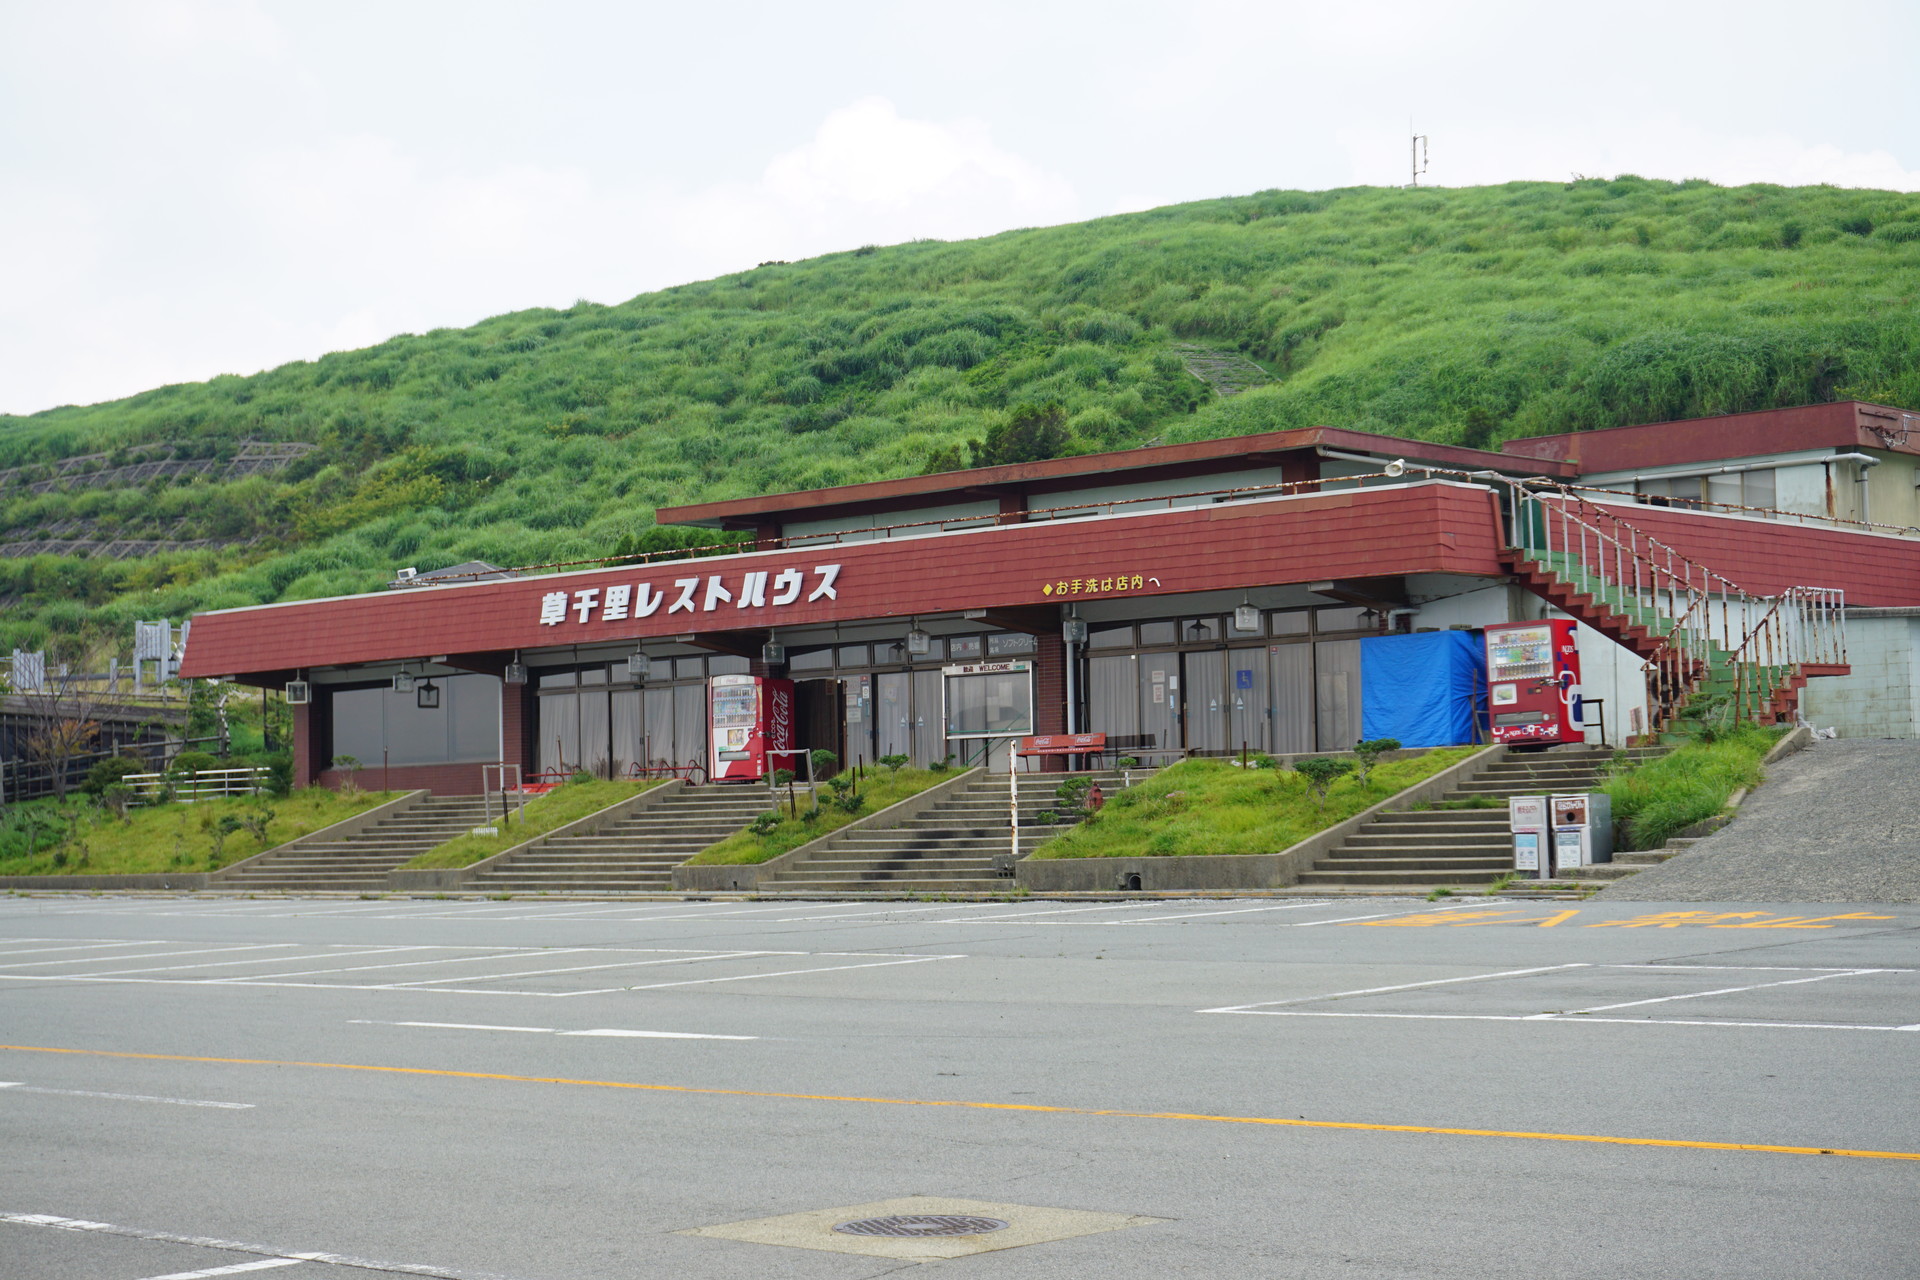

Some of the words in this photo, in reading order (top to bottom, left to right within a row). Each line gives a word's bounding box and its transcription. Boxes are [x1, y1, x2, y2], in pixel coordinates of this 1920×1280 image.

[539, 564, 842, 626] 草千里レストハウス
[979, 663, 1010, 672] WELCOME
